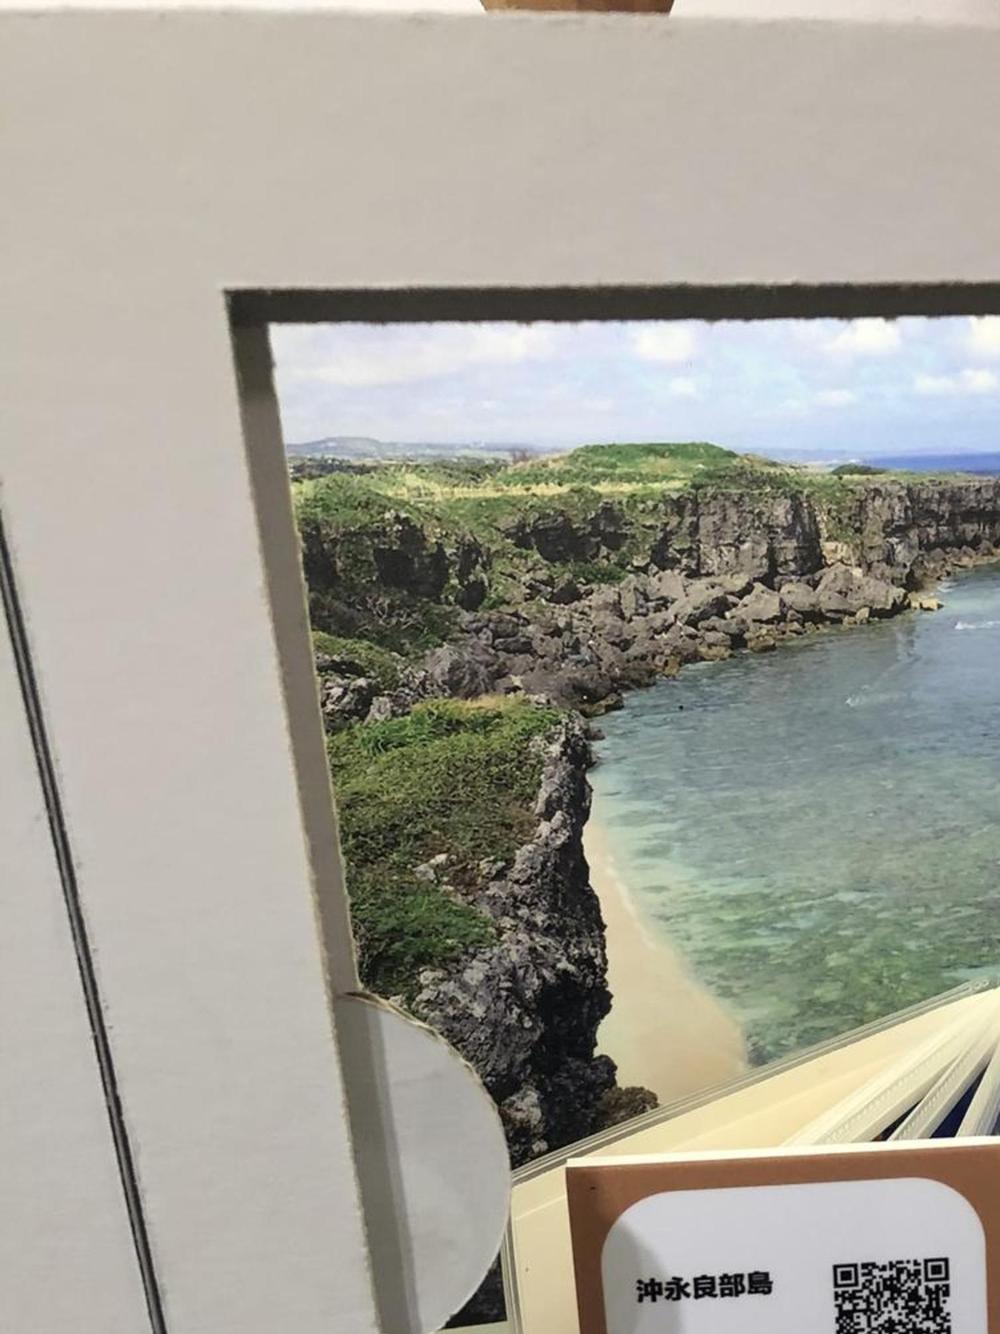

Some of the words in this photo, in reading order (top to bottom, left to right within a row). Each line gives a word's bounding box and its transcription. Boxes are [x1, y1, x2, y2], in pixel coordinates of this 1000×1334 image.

[637, 1271, 773, 1303] 沖永良部島
